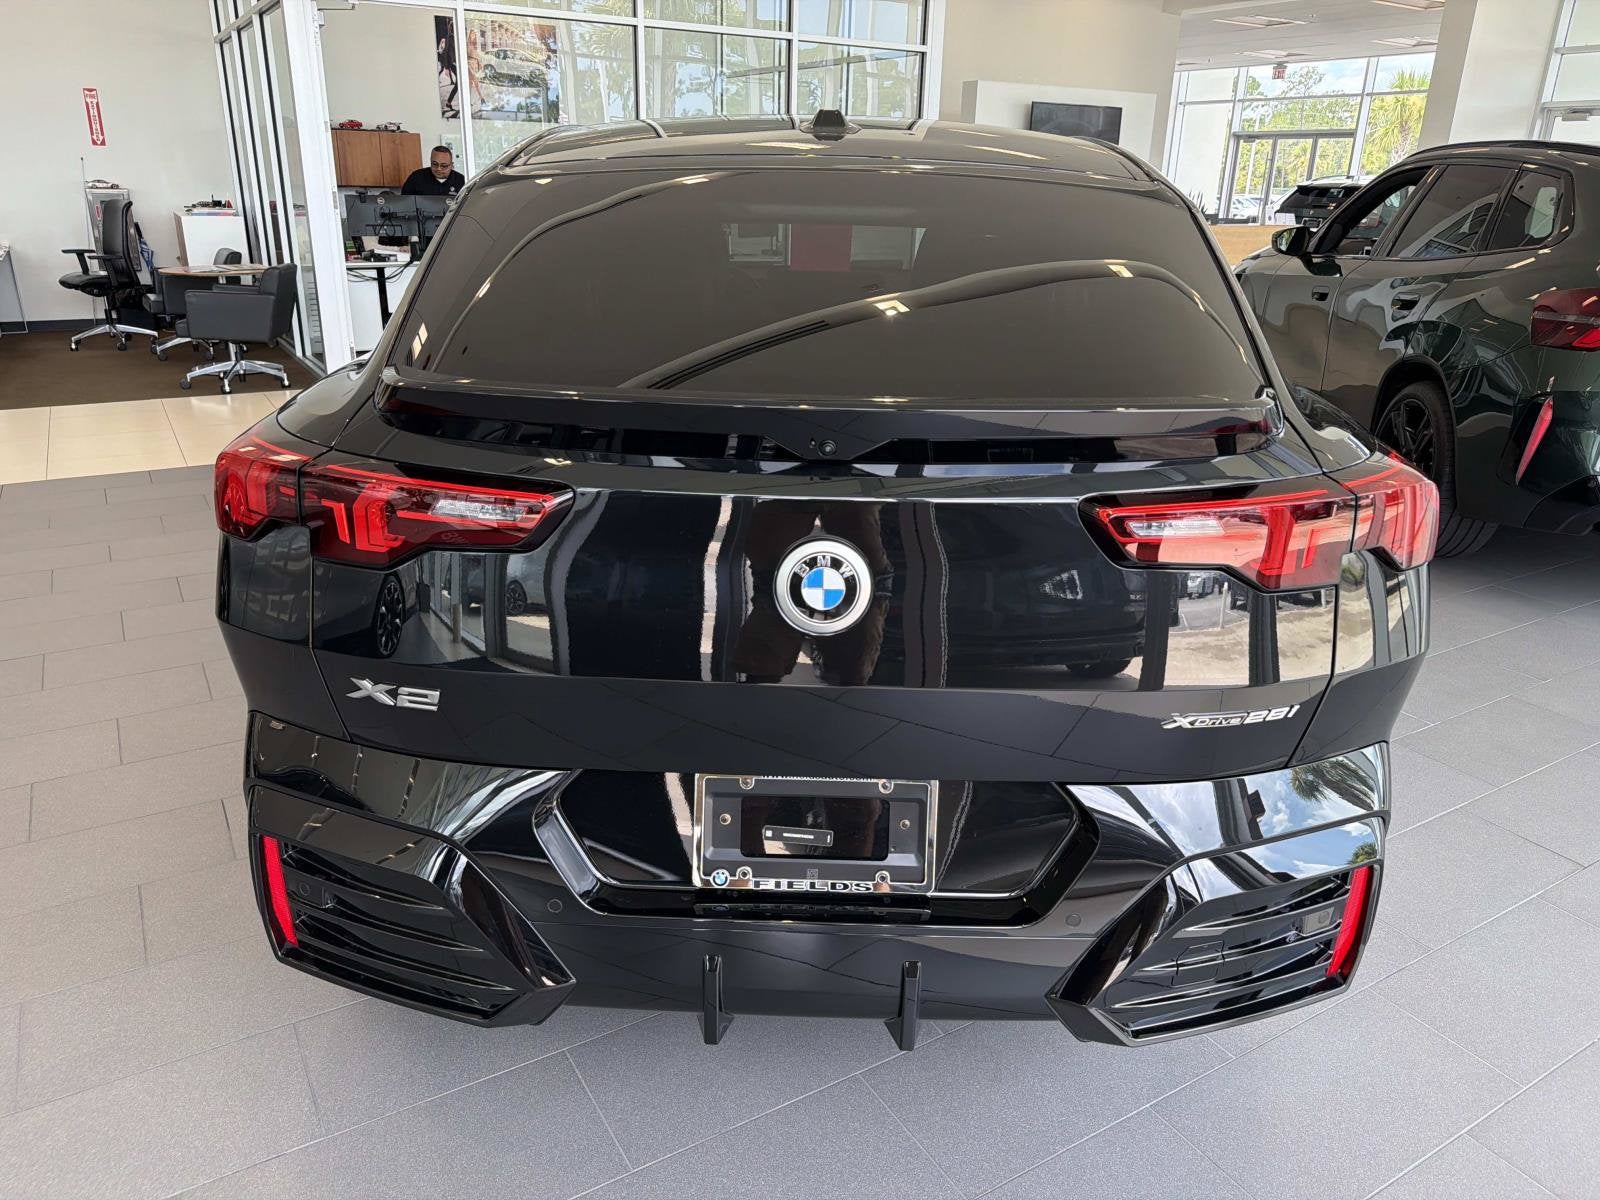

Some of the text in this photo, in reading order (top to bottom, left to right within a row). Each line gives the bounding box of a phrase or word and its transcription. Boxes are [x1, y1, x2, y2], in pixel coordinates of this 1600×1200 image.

[794, 554, 855, 579] BMW
[345, 677, 441, 712] X2
[752, 879, 874, 893] FIELDS
